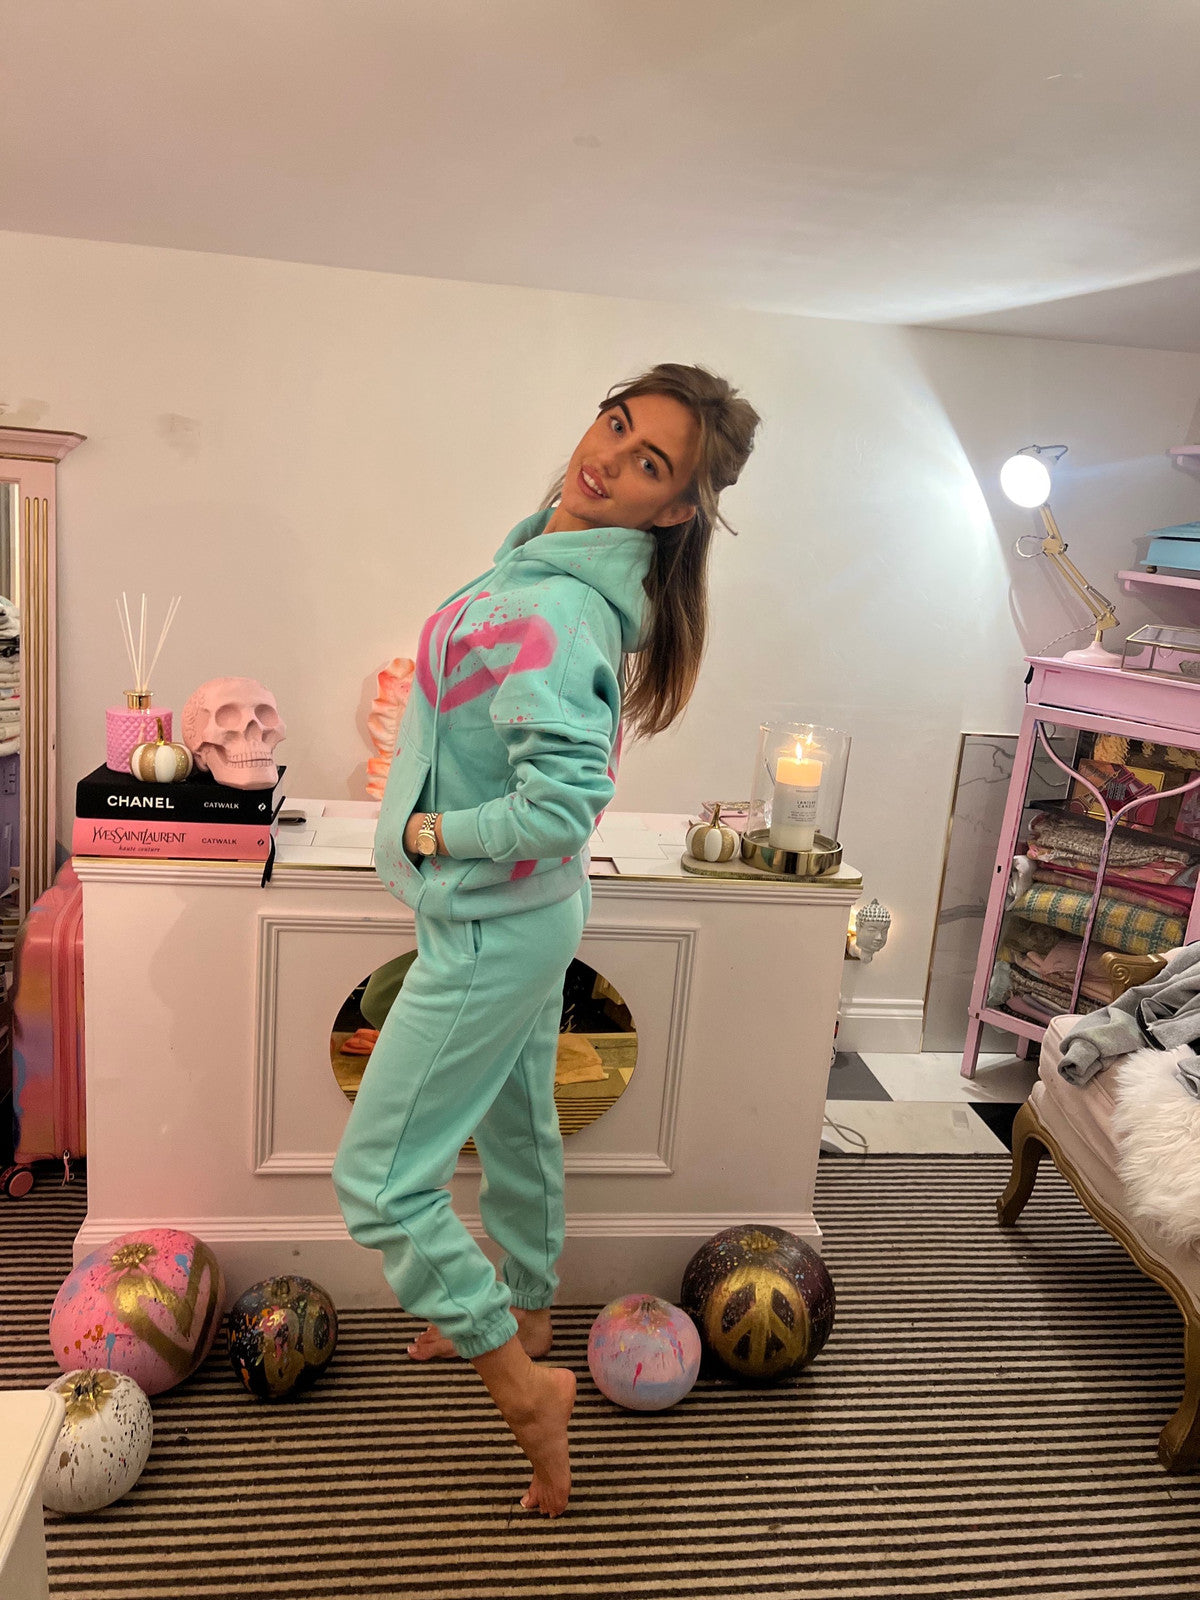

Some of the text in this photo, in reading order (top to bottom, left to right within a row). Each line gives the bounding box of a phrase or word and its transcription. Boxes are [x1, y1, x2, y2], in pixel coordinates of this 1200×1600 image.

[106, 795, 240, 809] CHANEL CATWALK
[201, 837, 238, 845] CATWALK
